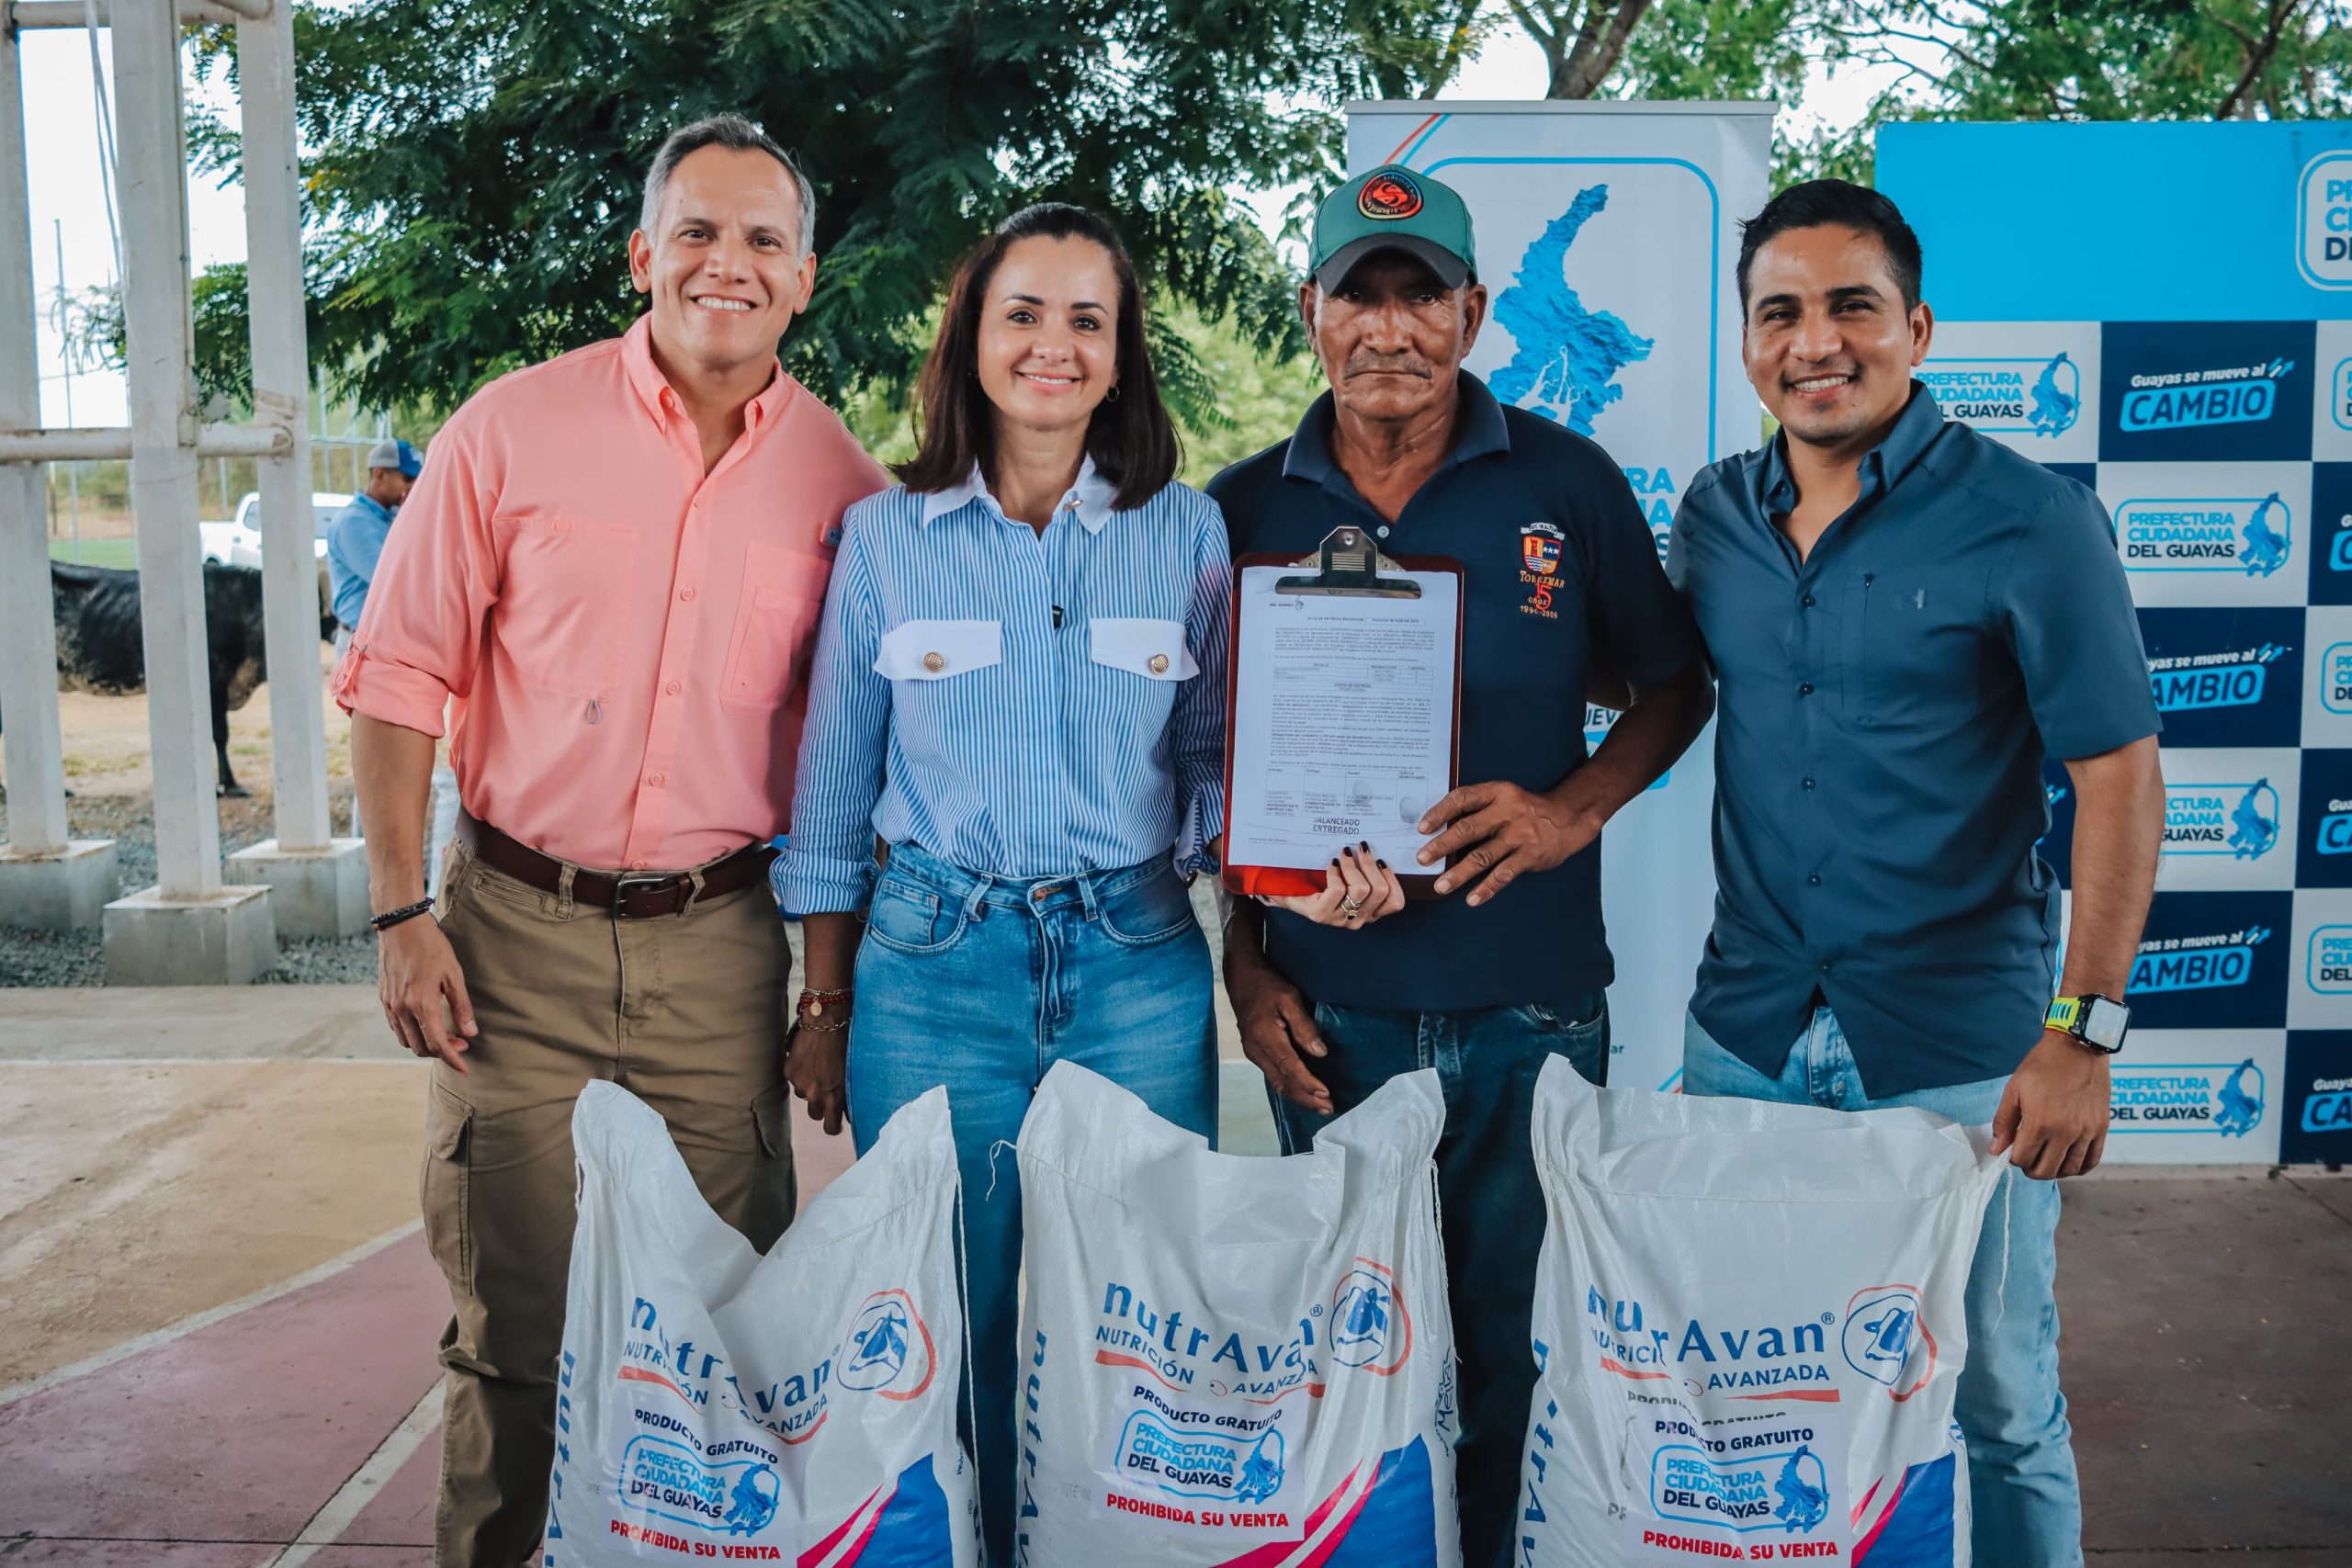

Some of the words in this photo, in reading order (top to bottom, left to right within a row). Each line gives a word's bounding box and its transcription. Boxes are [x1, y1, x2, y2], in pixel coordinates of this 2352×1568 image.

[1916, 372, 2024, 386] PREFECTURA
[2131, 374, 2182, 388] Guayas
[2184, 371, 2200, 382] se
[2202, 367, 2249, 381] mueve
[2252, 363, 2267, 377] al
[1954, 404, 2024, 418] GUAYAS
[2129, 386, 2267, 425] CAMBIO
[2128, 513, 2235, 525] PREFECTURA
[2128, 527, 2235, 541] CIUDADANA
[2127, 544, 2162, 558] DEL
[2166, 544, 2235, 558] GUAYAS
[2175, 655, 2191, 668] se
[2193, 651, 2240, 666] mueve
[2242, 648, 2256, 661] al
[2152, 670, 2257, 705] AMBIO
[1313, 825, 1360, 835] ENTREGADO
[2164, 938, 2178, 950] se
[2181, 934, 2227, 948] mueve
[2230, 931, 2244, 943] al
[2130, 952, 2244, 988] AMBIO
[2111, 1077, 2211, 1090] PREFECTURA
[2143, 1108, 2211, 1120] GUAYAS
[1096, 1325, 1194, 1384] NUTRICIÓN
[1707, 1364, 1830, 1390] AVANZADA
[1134, 1385, 1211, 1424] PRODUCTO
[1215, 1409, 1283, 1432] GRATUITO
[635, 1409, 702, 1451] PRODUCTO
[707, 1440, 778, 1464] GRATUITO
[1136, 1422, 1237, 1461] PREFECTURA
[1731, 1428, 1814, 1450] GRATUITO
[638, 1448, 727, 1490] PREFECTURA
[1127, 1454, 1160, 1473] DEL
[1164, 1465, 1233, 1489] GUAYAS
[1132, 1438, 1235, 1475] CIUDADANA
[634, 1463, 724, 1504] CIUDADANA
[631, 1480, 662, 1501] DEL
[663, 1489, 722, 1518] GUAYAS
[1106, 1494, 1196, 1525] PROHIBIDA
[1201, 1512, 1225, 1527] SU
[1229, 1513, 1290, 1528] VENTA
[1663, 1489, 1701, 1508] DEL
[1705, 1495, 1770, 1519] GUAYAS
[611, 1519, 690, 1553] PROHIBIDA
[695, 1542, 717, 1556] SU
[722, 1545, 781, 1560] VENTA
[1644, 1530, 1745, 1560] PROHIBIDA
[1750, 1544, 1774, 1560] SU
[1780, 1541, 1838, 1558] VENTA
